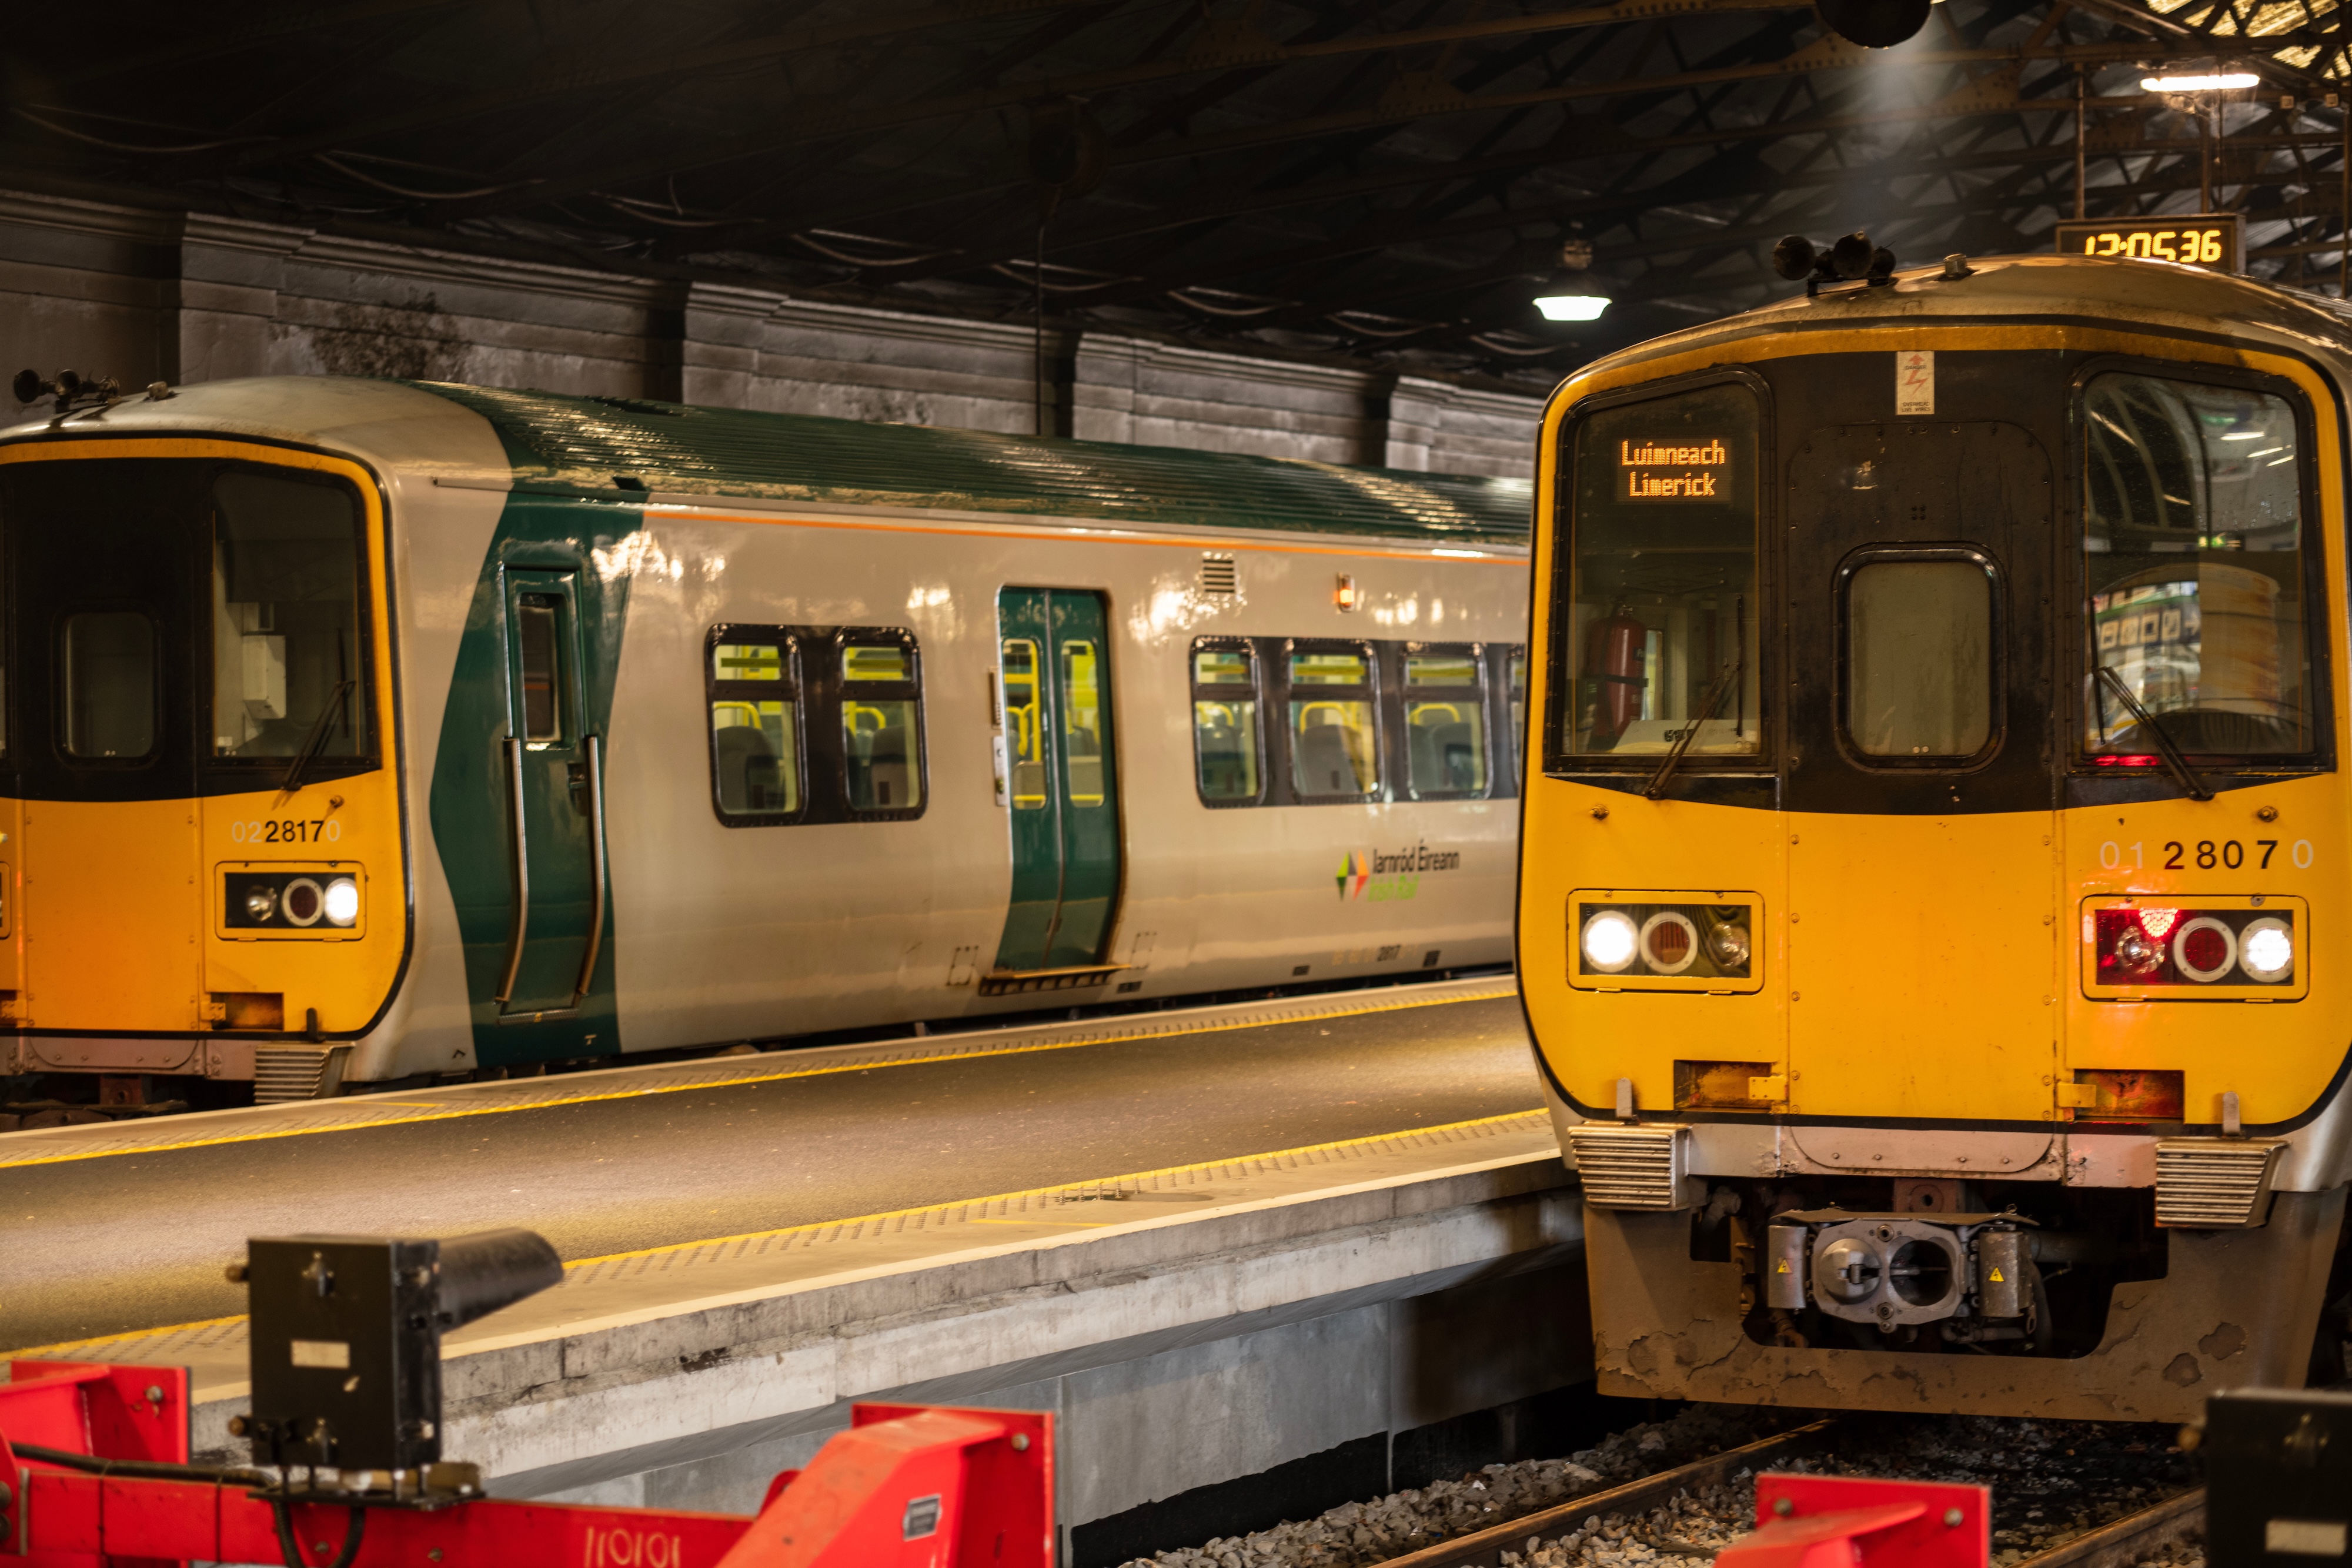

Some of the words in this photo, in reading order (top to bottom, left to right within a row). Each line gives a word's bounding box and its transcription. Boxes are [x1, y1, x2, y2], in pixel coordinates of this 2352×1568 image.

[1621, 439, 1725, 466] Luimneach
[1629, 472, 1716, 497] Limerick
[1372, 846, 1416, 874] Iarnród
